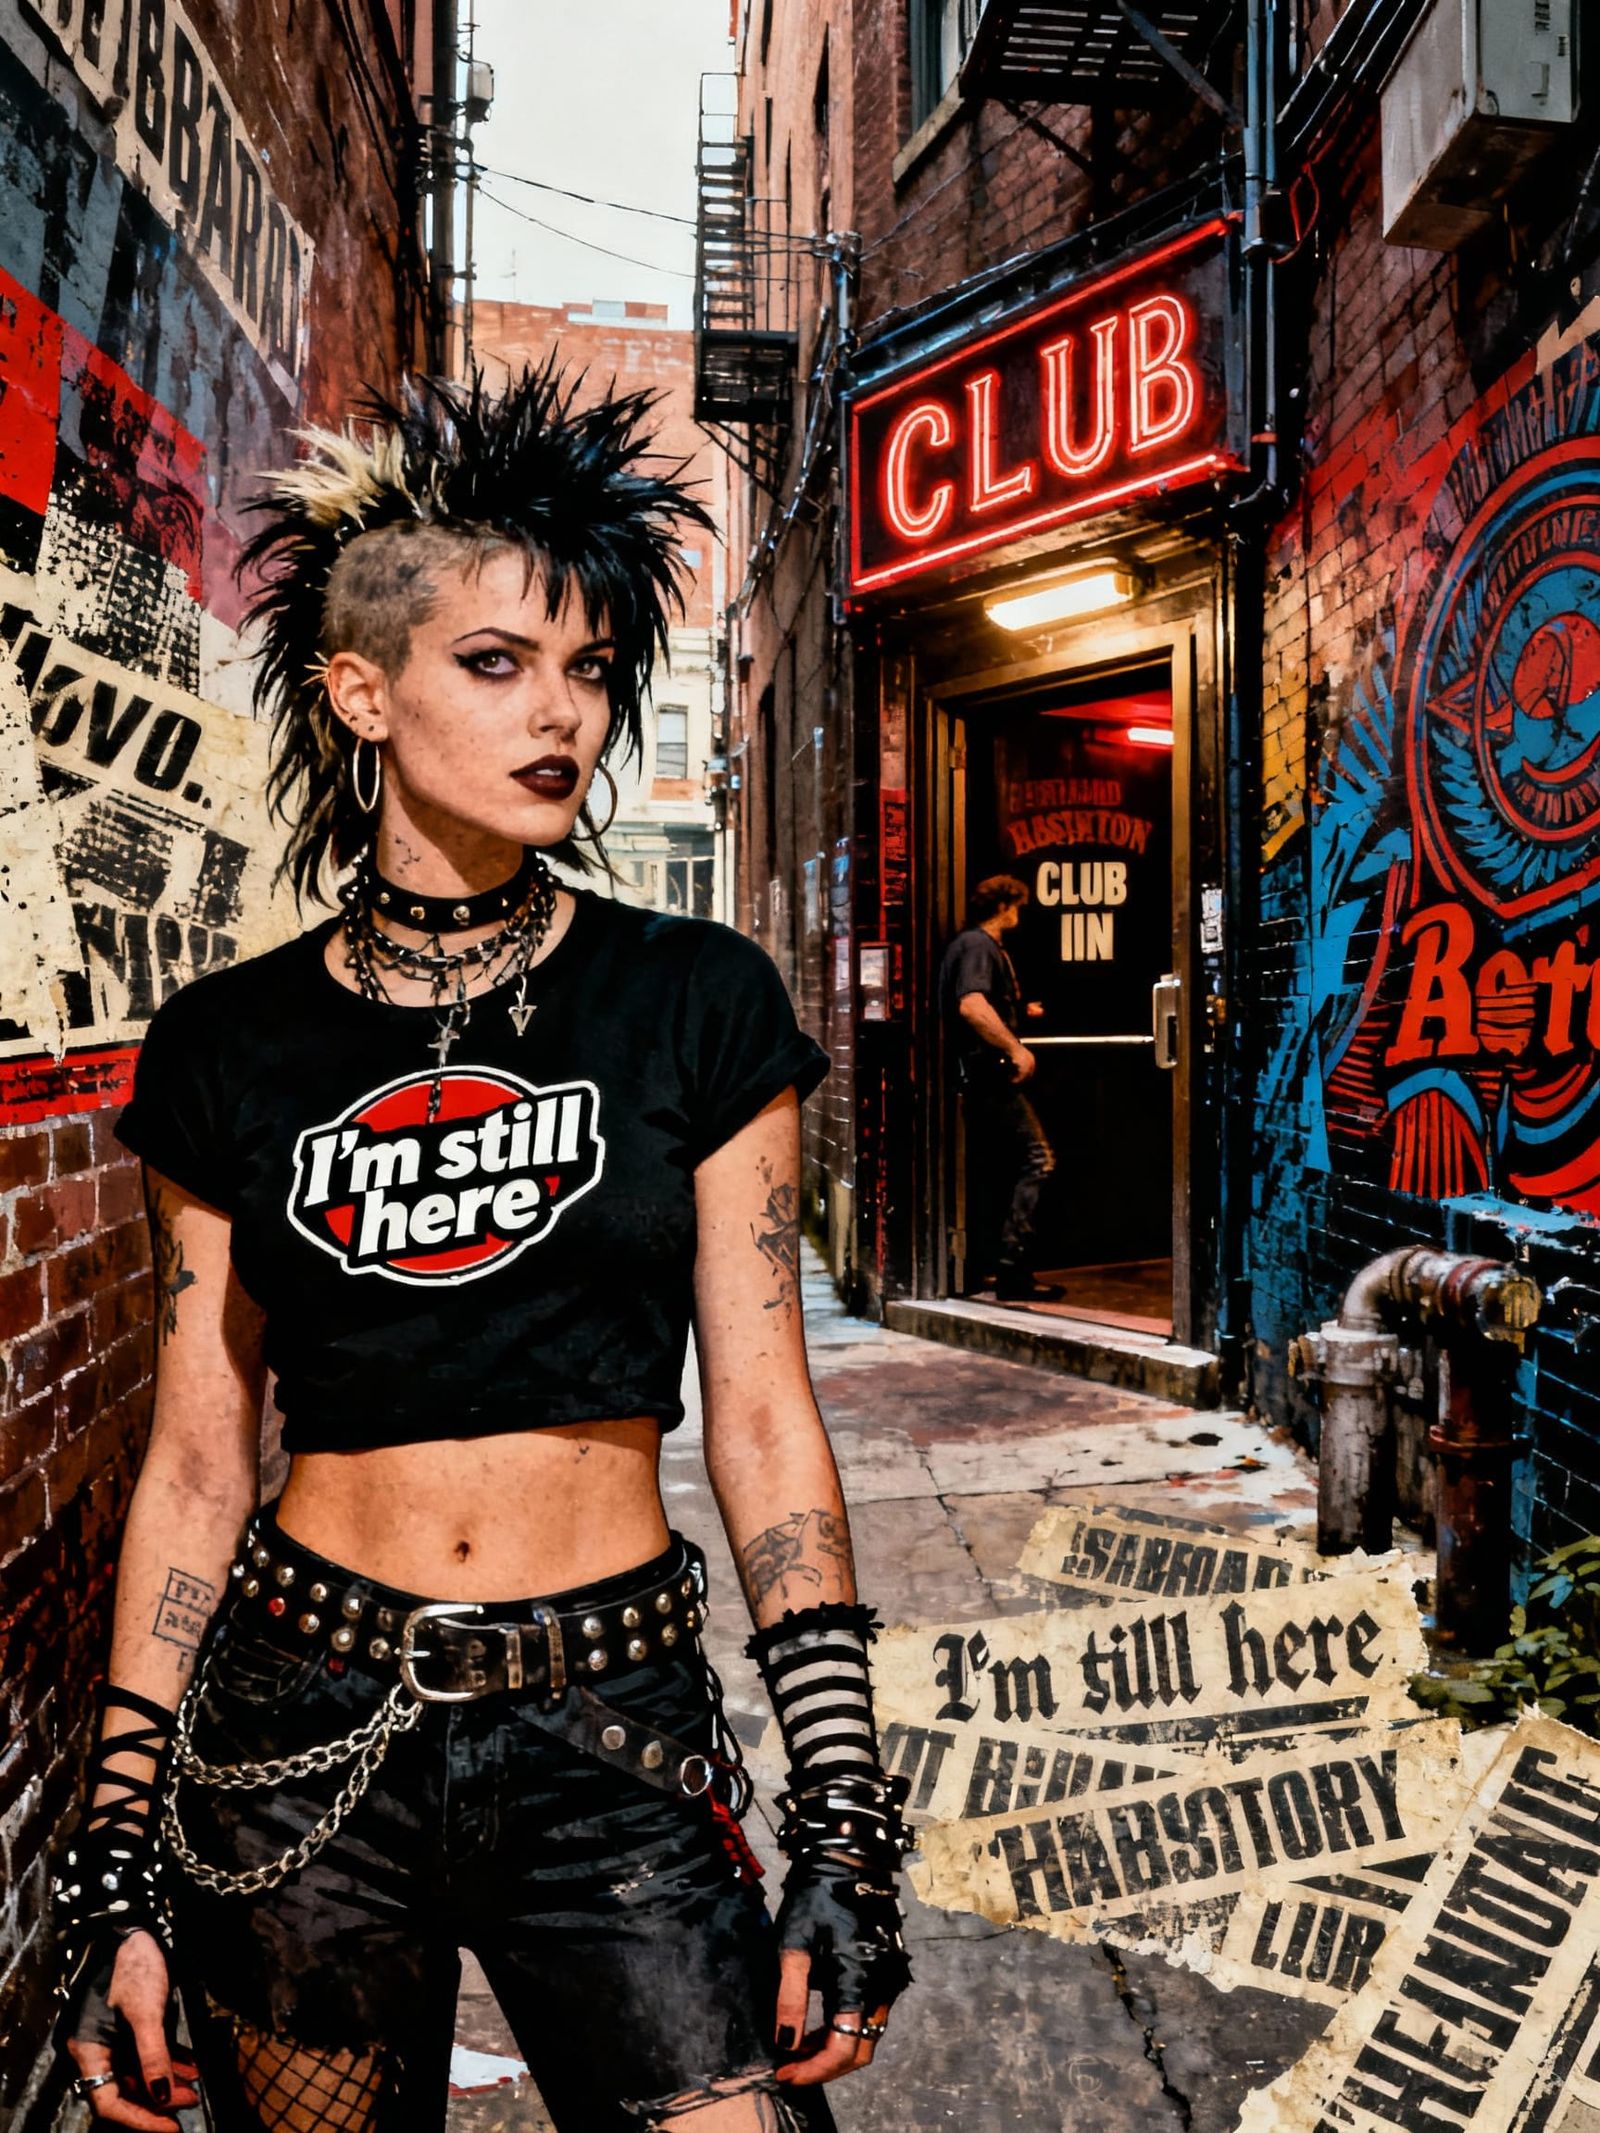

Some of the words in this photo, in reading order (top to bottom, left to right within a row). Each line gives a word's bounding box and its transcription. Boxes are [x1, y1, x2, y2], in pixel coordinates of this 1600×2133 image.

[886, 294, 1194, 538] CLUB
[1036, 861, 1128, 907] CLUB
[303, 1128, 421, 1208] I'm
[434, 1093, 583, 1180] still
[357, 1177, 541, 1257] here
[1218, 1598, 1385, 1699] here
